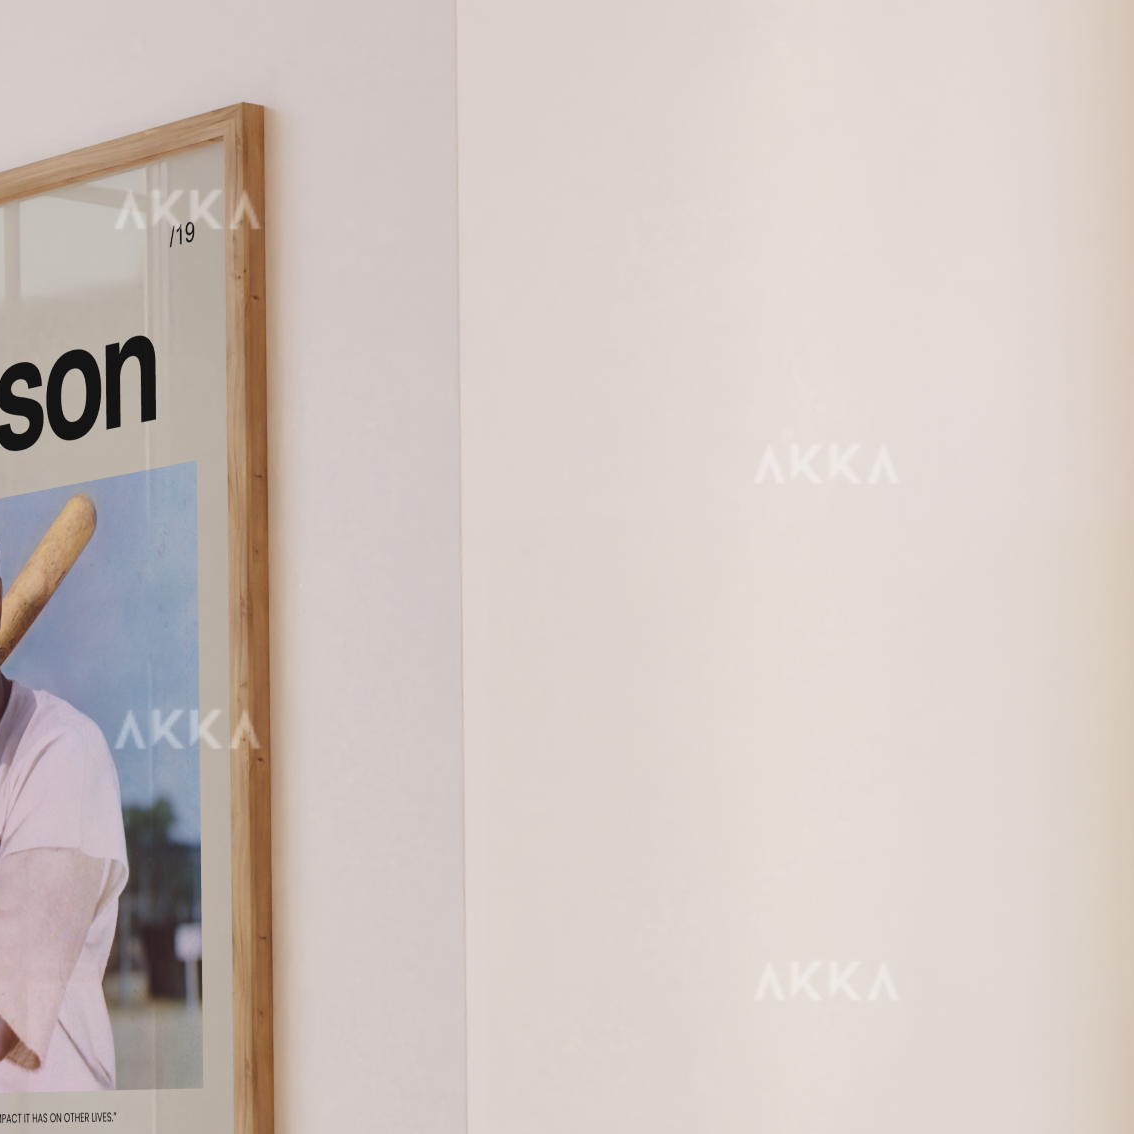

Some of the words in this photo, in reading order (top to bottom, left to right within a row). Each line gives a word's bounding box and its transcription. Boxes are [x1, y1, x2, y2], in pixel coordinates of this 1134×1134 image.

[169, 221, 196, 248] /19
[24, 1113, 31, 1124] IT
[33, 1113, 48, 1123] HAS
[50, 1112, 62, 1123] ON
[64, 1112, 90, 1123] OTHER
